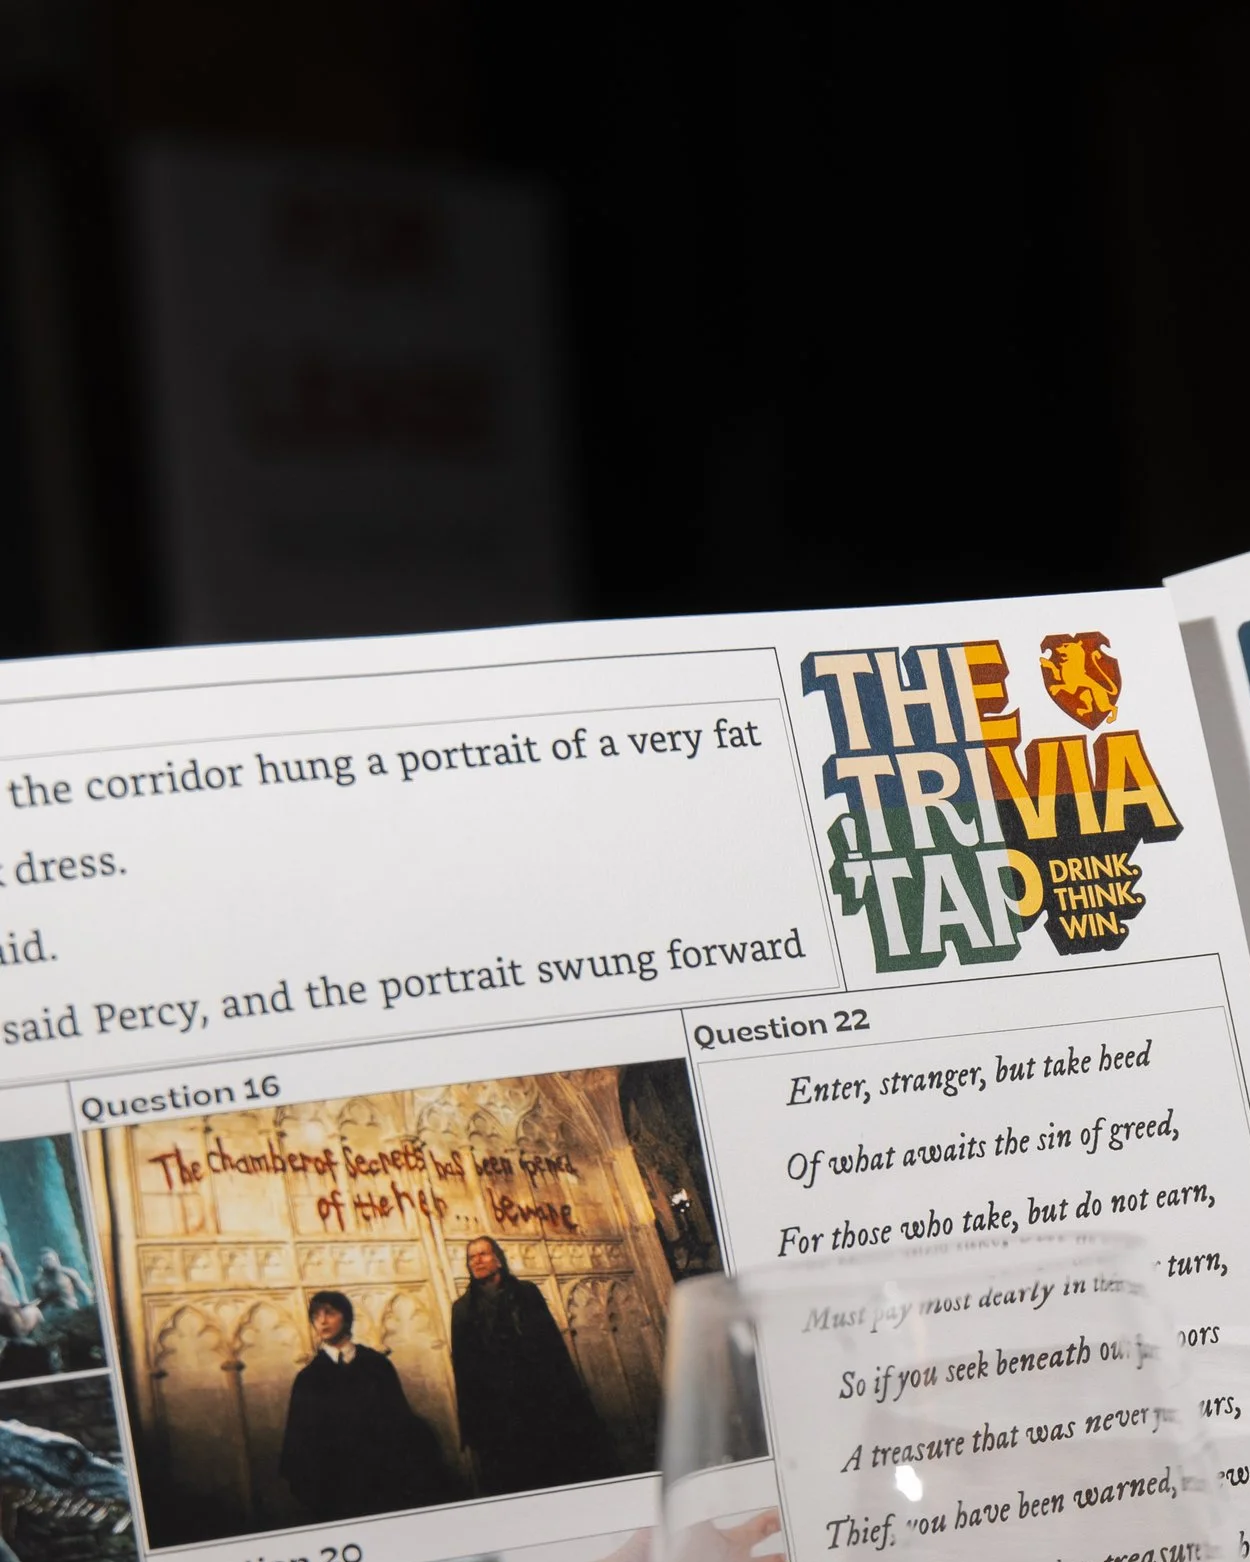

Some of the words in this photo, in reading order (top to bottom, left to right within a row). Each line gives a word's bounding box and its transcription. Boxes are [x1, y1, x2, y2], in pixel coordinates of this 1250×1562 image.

[814, 641, 1020, 750] THE
[8, 774, 72, 809] the
[86, 759, 244, 801] corridor
[255, 753, 356, 787] hung
[396, 733, 542, 782] portrait
[551, 727, 588, 761] of
[627, 729, 703, 760] very
[713, 717, 762, 749] fat
[836, 734, 1176, 854] TRIVIA
[15, 851, 127, 885] dress.
[1049, 854, 1138, 883] DRINK.
[1053, 882, 1142, 911] THINK.
[860, 849, 1045, 956] TAP
[1059, 911, 1126, 939] WIN.
[3, 1004, 82, 1045] said
[93, 1000, 209, 1034] Percy,
[222, 980, 295, 1019] and
[305, 975, 367, 1009] the
[378, 956, 526, 1010] portrait
[537, 950, 659, 984] swung
[666, 927, 807, 970] forward
[693, 1015, 828, 1051] Question
[833, 1008, 871, 1033] 22
[81, 1085, 235, 1123] Question
[243, 1075, 281, 1100] 16
[785, 1075, 871, 1107] Enter,
[879, 1066, 987, 1098] stranger,
[994, 1054, 1037, 1083] but
[1043, 1045, 1092, 1078] take
[1098, 1038, 1153, 1072] heed
[149, 1142, 205, 1191] The
[345, 1142, 426, 1179] Secrets
[430, 1151, 463, 1181] has
[787, 1151, 823, 1189] Of
[828, 1142, 895, 1177] what
[902, 1132, 987, 1165] awaits
[994, 1126, 1030, 1155] the
[1037, 1121, 1073, 1152] sin
[1107, 1109, 1180, 1152] greed,
[777, 1225, 825, 1258] For
[831, 1219, 892, 1251] those
[900, 1208, 954, 1241] who
[962, 1200, 1019, 1234] take,
[1026, 1196, 1069, 1225] but
[1075, 1190, 1102, 1219] do
[1110, 1188, 1150, 1214] not
[1156, 1184, 1216, 1209] earn,
[839, 1369, 867, 1400] So
[945, 1350, 990, 1382] seek
[996, 1338, 1091, 1379] beneath
[841, 1443, 862, 1472] A
[871, 1433, 965, 1471] treasure
[972, 1421, 1019, 1453] that
[1025, 1415, 1076, 1445] was
[1085, 1406, 1154, 1436] never
[953, 1498, 1010, 1531] have
[1017, 1487, 1064, 1519] been
[1073, 1472, 1177, 1508] warned,
